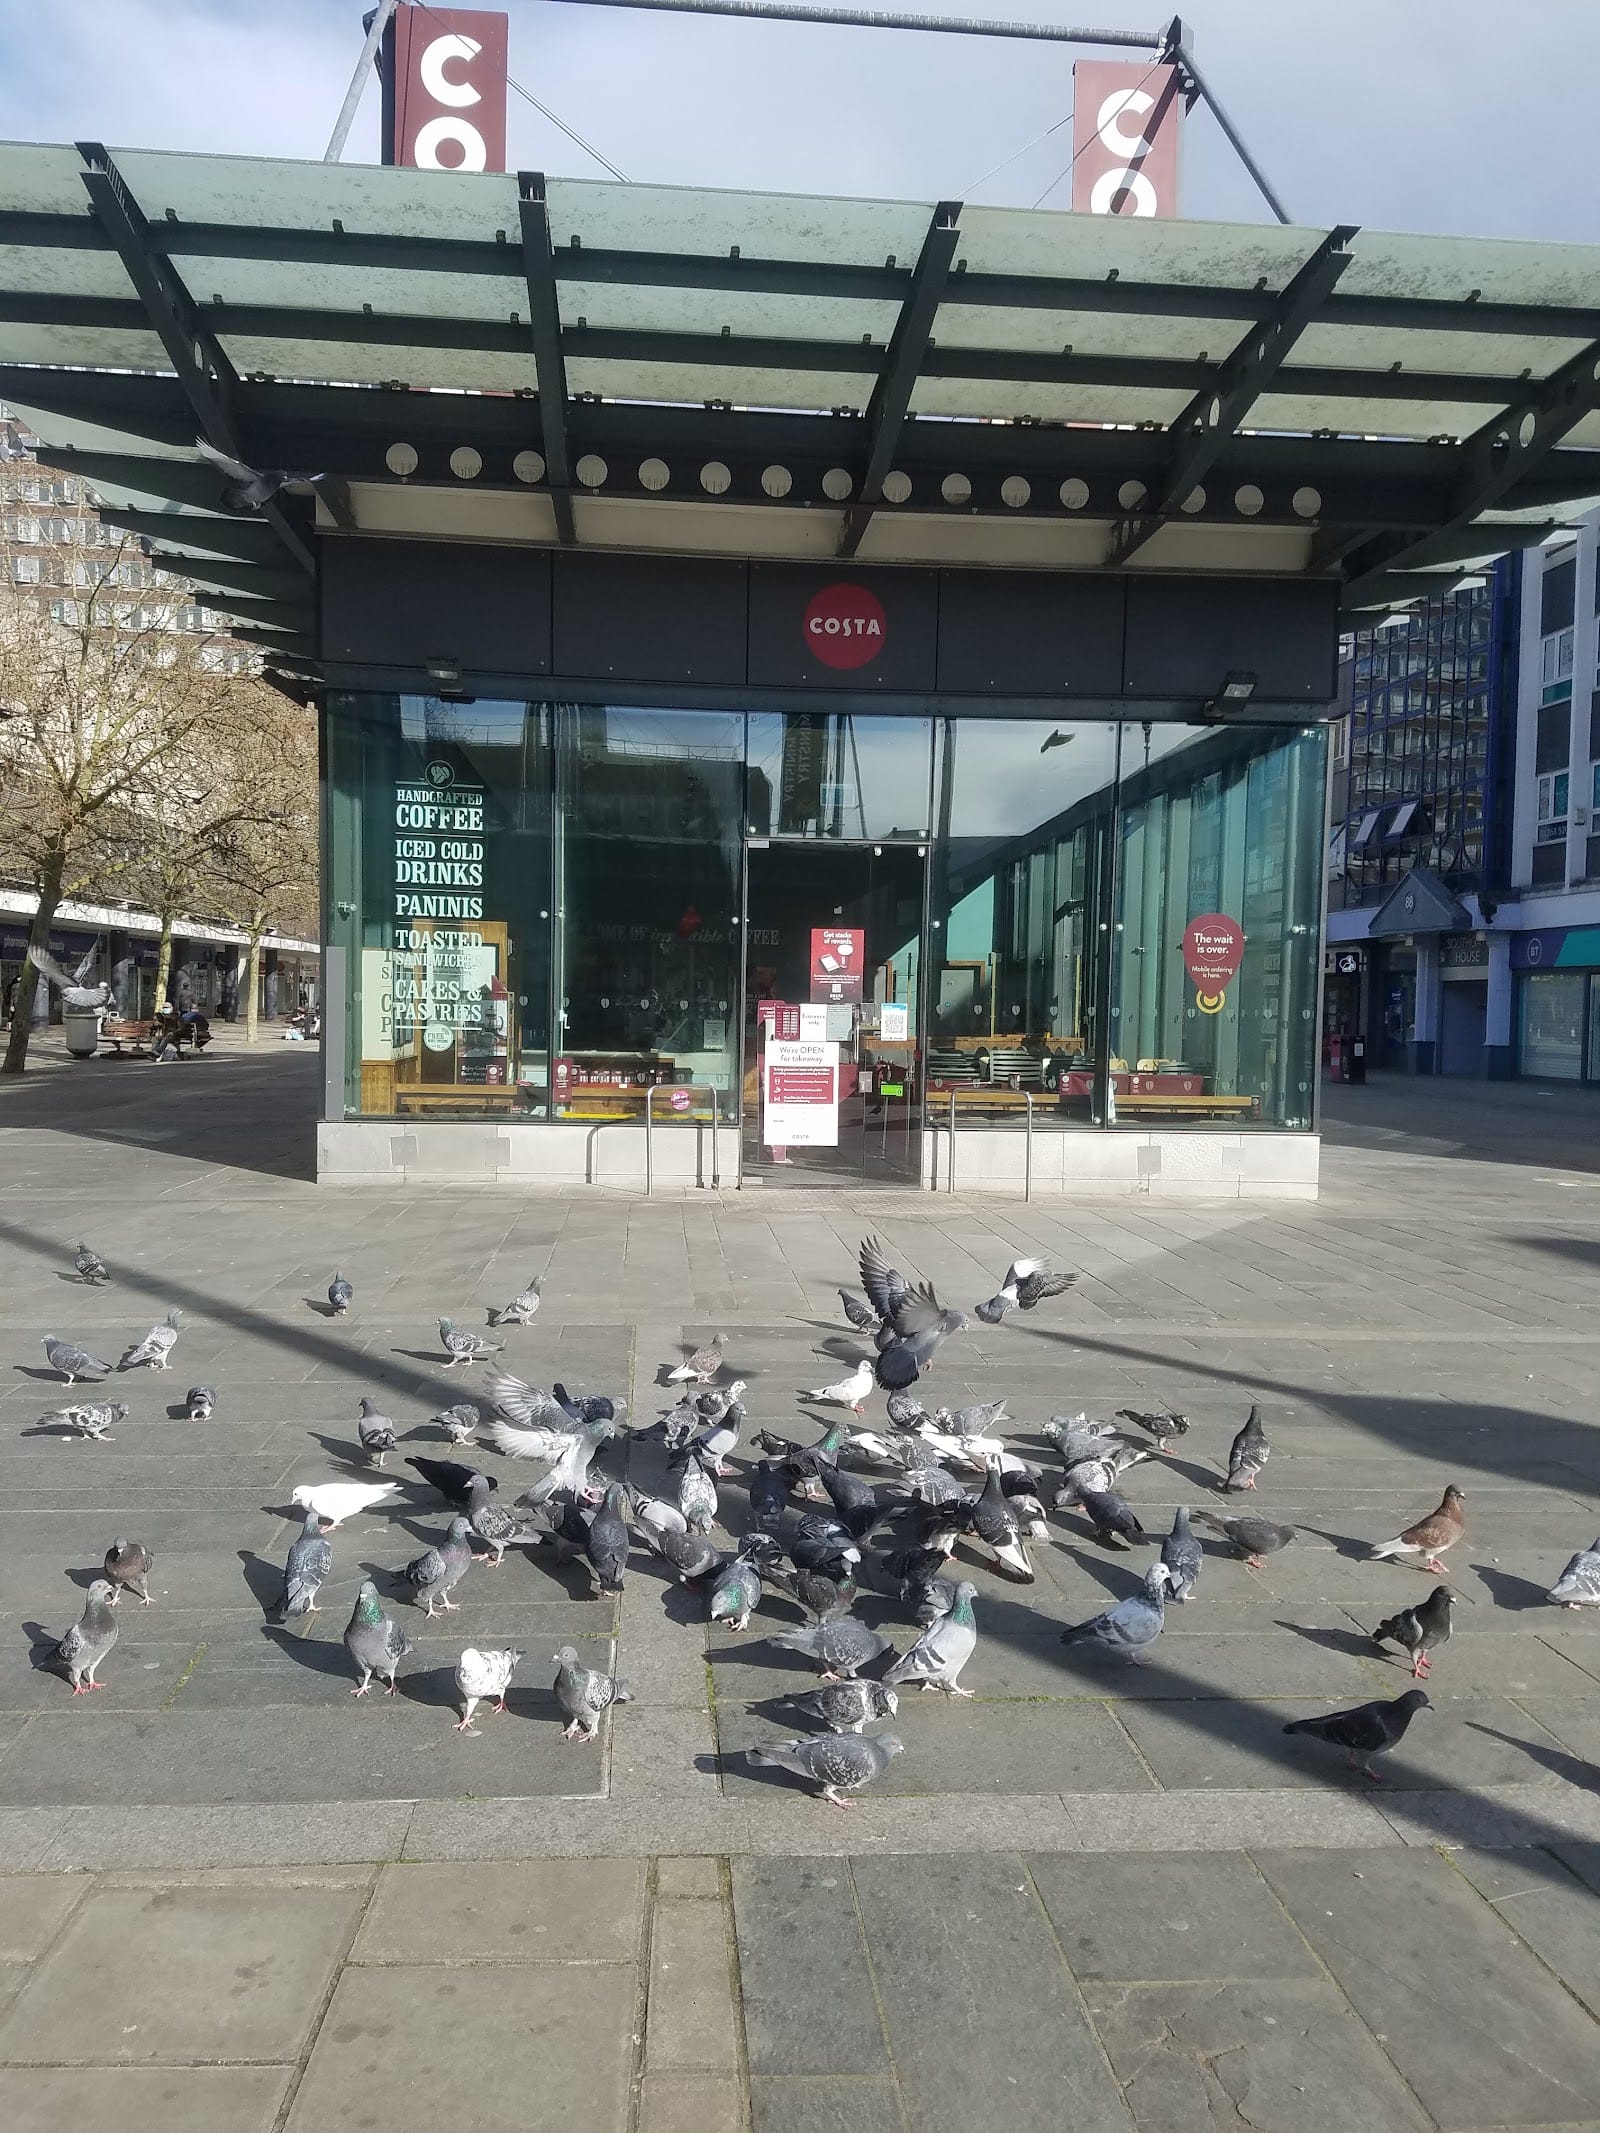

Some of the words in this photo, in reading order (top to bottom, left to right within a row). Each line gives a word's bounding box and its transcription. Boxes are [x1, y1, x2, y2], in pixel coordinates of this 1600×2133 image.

[809, 617, 881, 637] COSTA
[397, 789, 483, 806] HANDCRAFTED
[396, 804, 483, 831] COFFEE
[395, 839, 436, 859] ICED
[440, 841, 484, 861] COLD
[396, 860, 483, 886] DRINKS
[396, 894, 483, 919] PANINIS
[395, 929, 483, 950] TOASTED
[728, 928, 780, 945] CFFEE
[1193, 932, 1212, 943] The
[1213, 934, 1234, 944] wait
[1197, 944, 1205, 954] is
[1206, 946, 1229, 954] over.
[1455, 950, 1480, 963] HOUSE
[395, 952, 482, 969] SANWICH
[1210, 966, 1233, 975] ordering
[395, 979, 461, 1001] CAKES
[466, 989, 483, 1002] &
[395, 1002, 483, 1022] PASTRIES
[779, 1046, 799, 1054] We're
[799, 1046, 825, 1054] OPEN
[780, 1054, 791, 1062] for
[792, 1054, 823, 1065] takeaway
